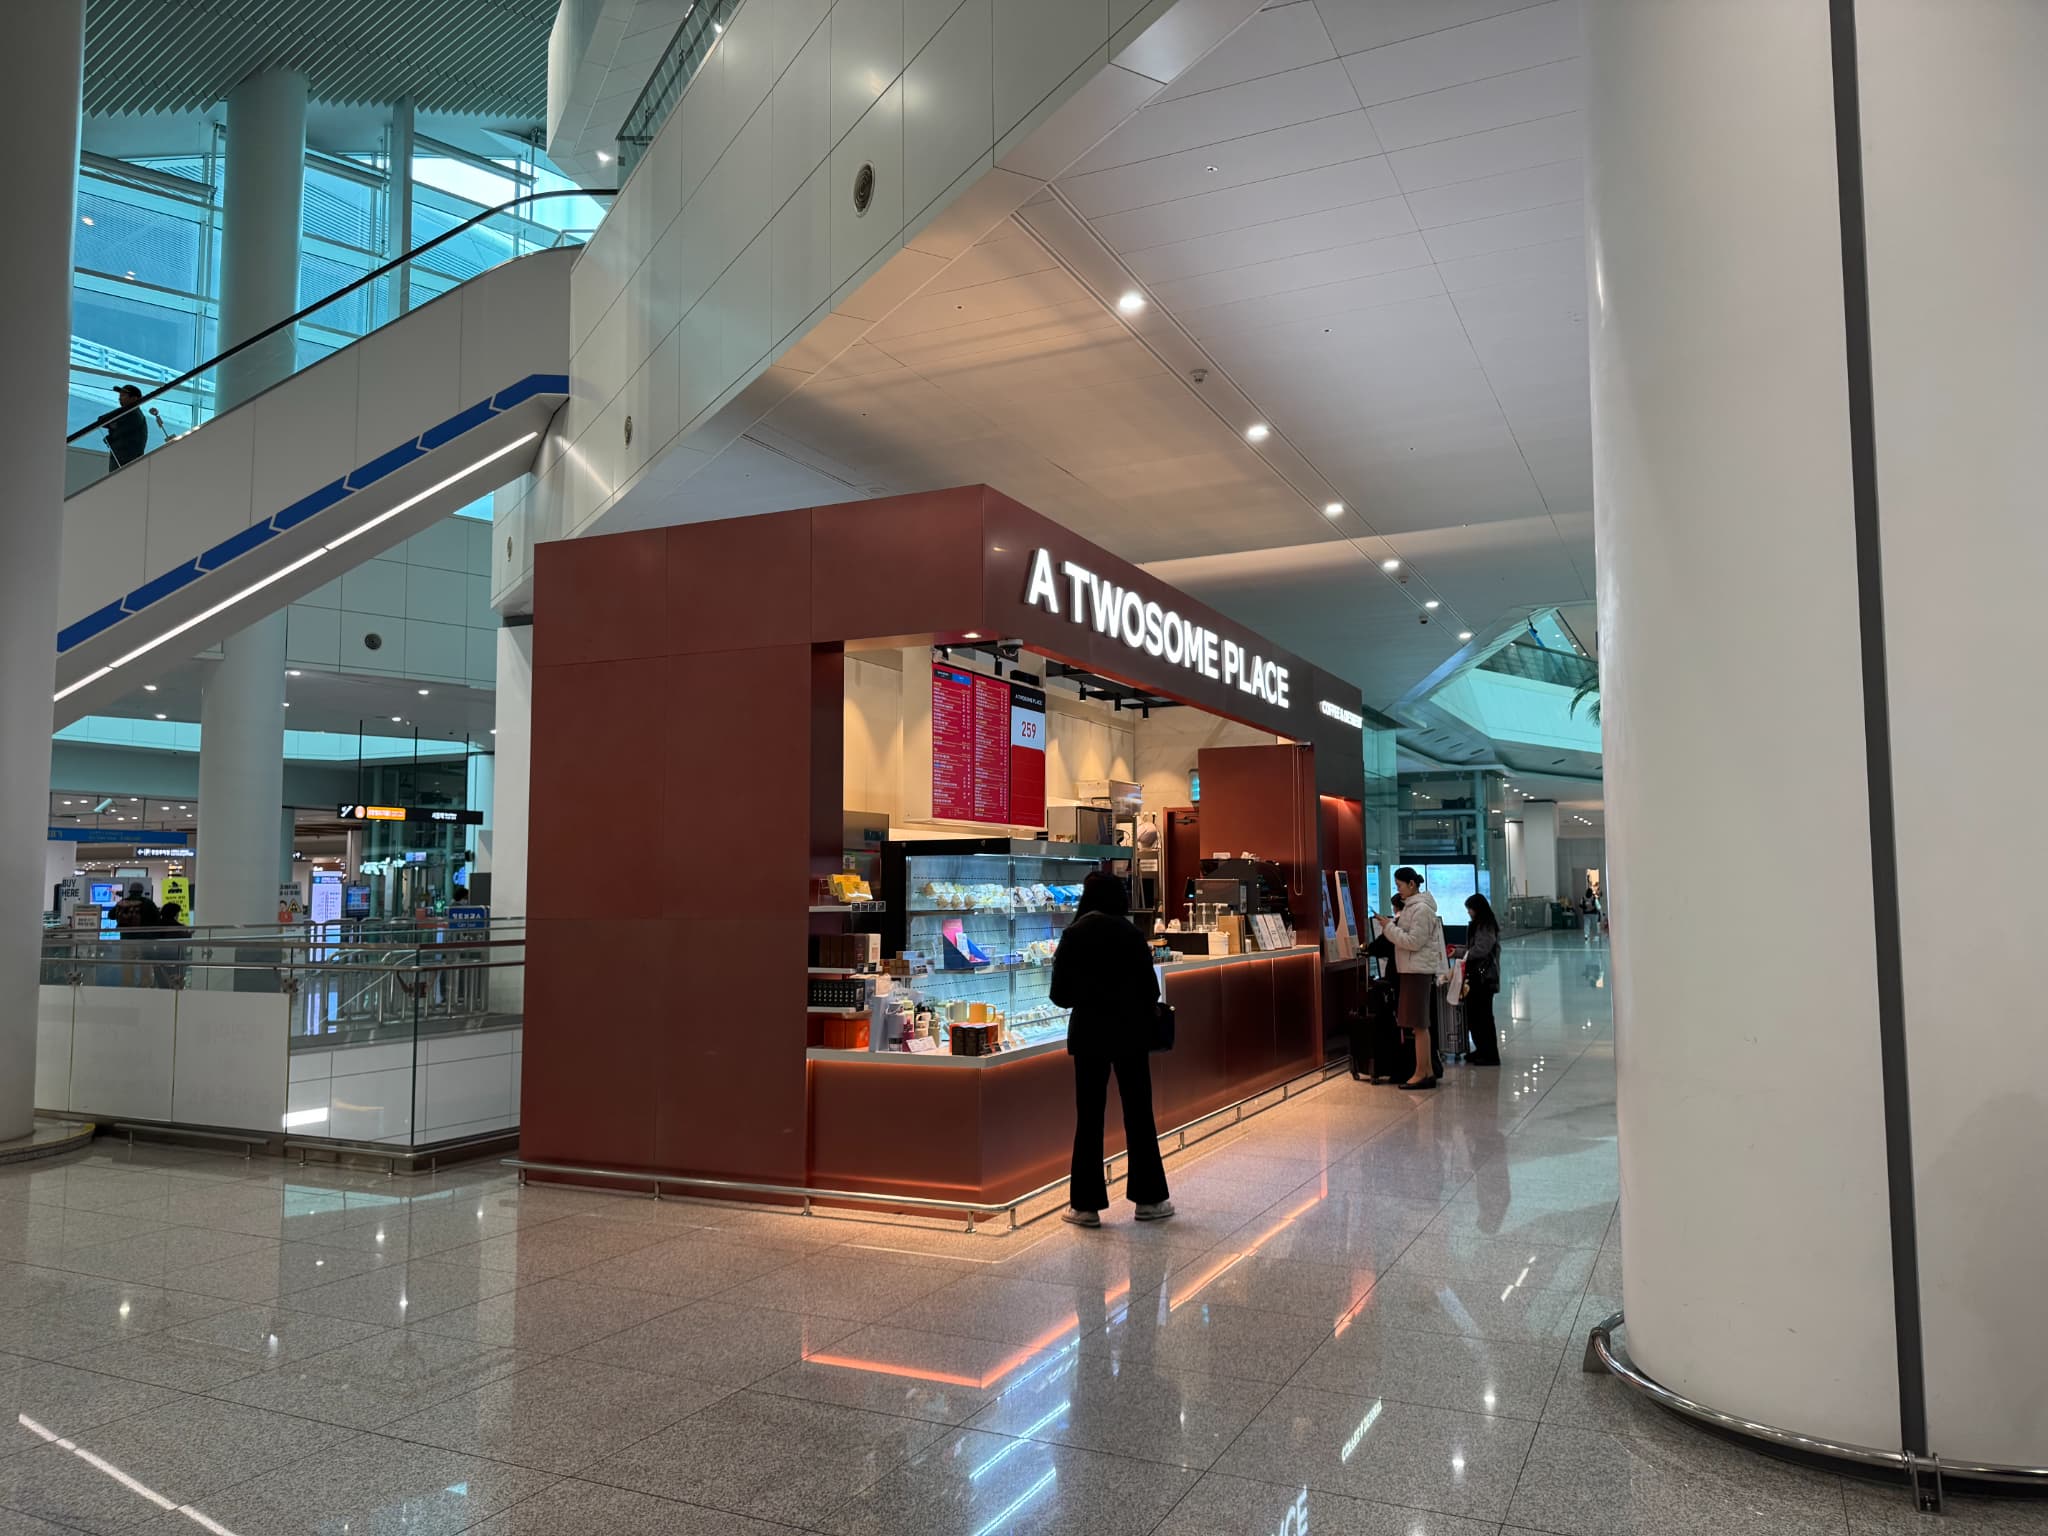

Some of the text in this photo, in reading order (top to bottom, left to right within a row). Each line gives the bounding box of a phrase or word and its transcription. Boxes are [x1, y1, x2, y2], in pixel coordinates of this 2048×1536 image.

[1026, 548, 1289, 708] A TWOSOME PLACE
[1021, 720, 1037, 739] 259
[62, 879, 76, 888] BUY
[62, 888, 80, 897] HERE
